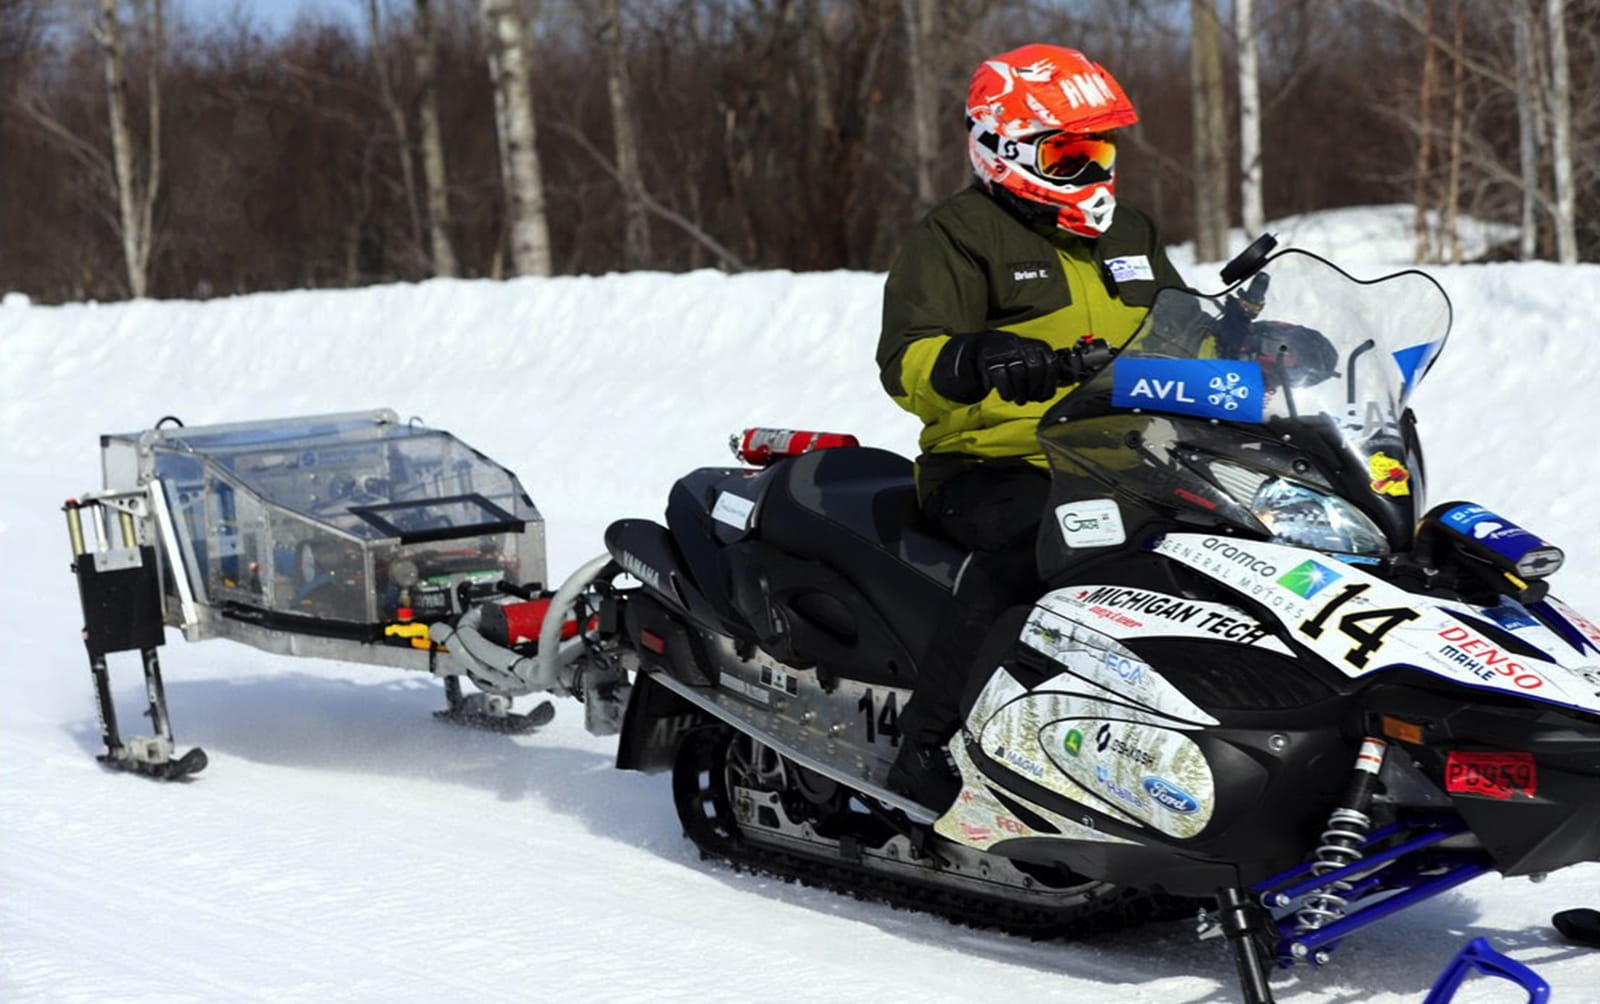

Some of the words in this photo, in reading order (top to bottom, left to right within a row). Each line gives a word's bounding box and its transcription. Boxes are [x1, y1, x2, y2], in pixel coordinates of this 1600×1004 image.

[1130, 378, 1195, 403] AVL
[623, 550, 660, 587] YAMAHA
[1202, 537, 1277, 578] aramco
[1161, 539, 1231, 578] GENERAL
[1239, 578, 1306, 619] MOTORS
[1084, 587, 1203, 623] MICHIGAN
[1197, 612, 1267, 645] TECH
[1298, 583, 1420, 670] 14
[1105, 654, 1143, 685] FCA
[1438, 626, 1543, 689] DENSO
[1440, 645, 1496, 681] MAHLE
[858, 688, 900, 747] 14
[1006, 751, 1045, 779] MAGNA
[1149, 781, 1188, 811] Ford
